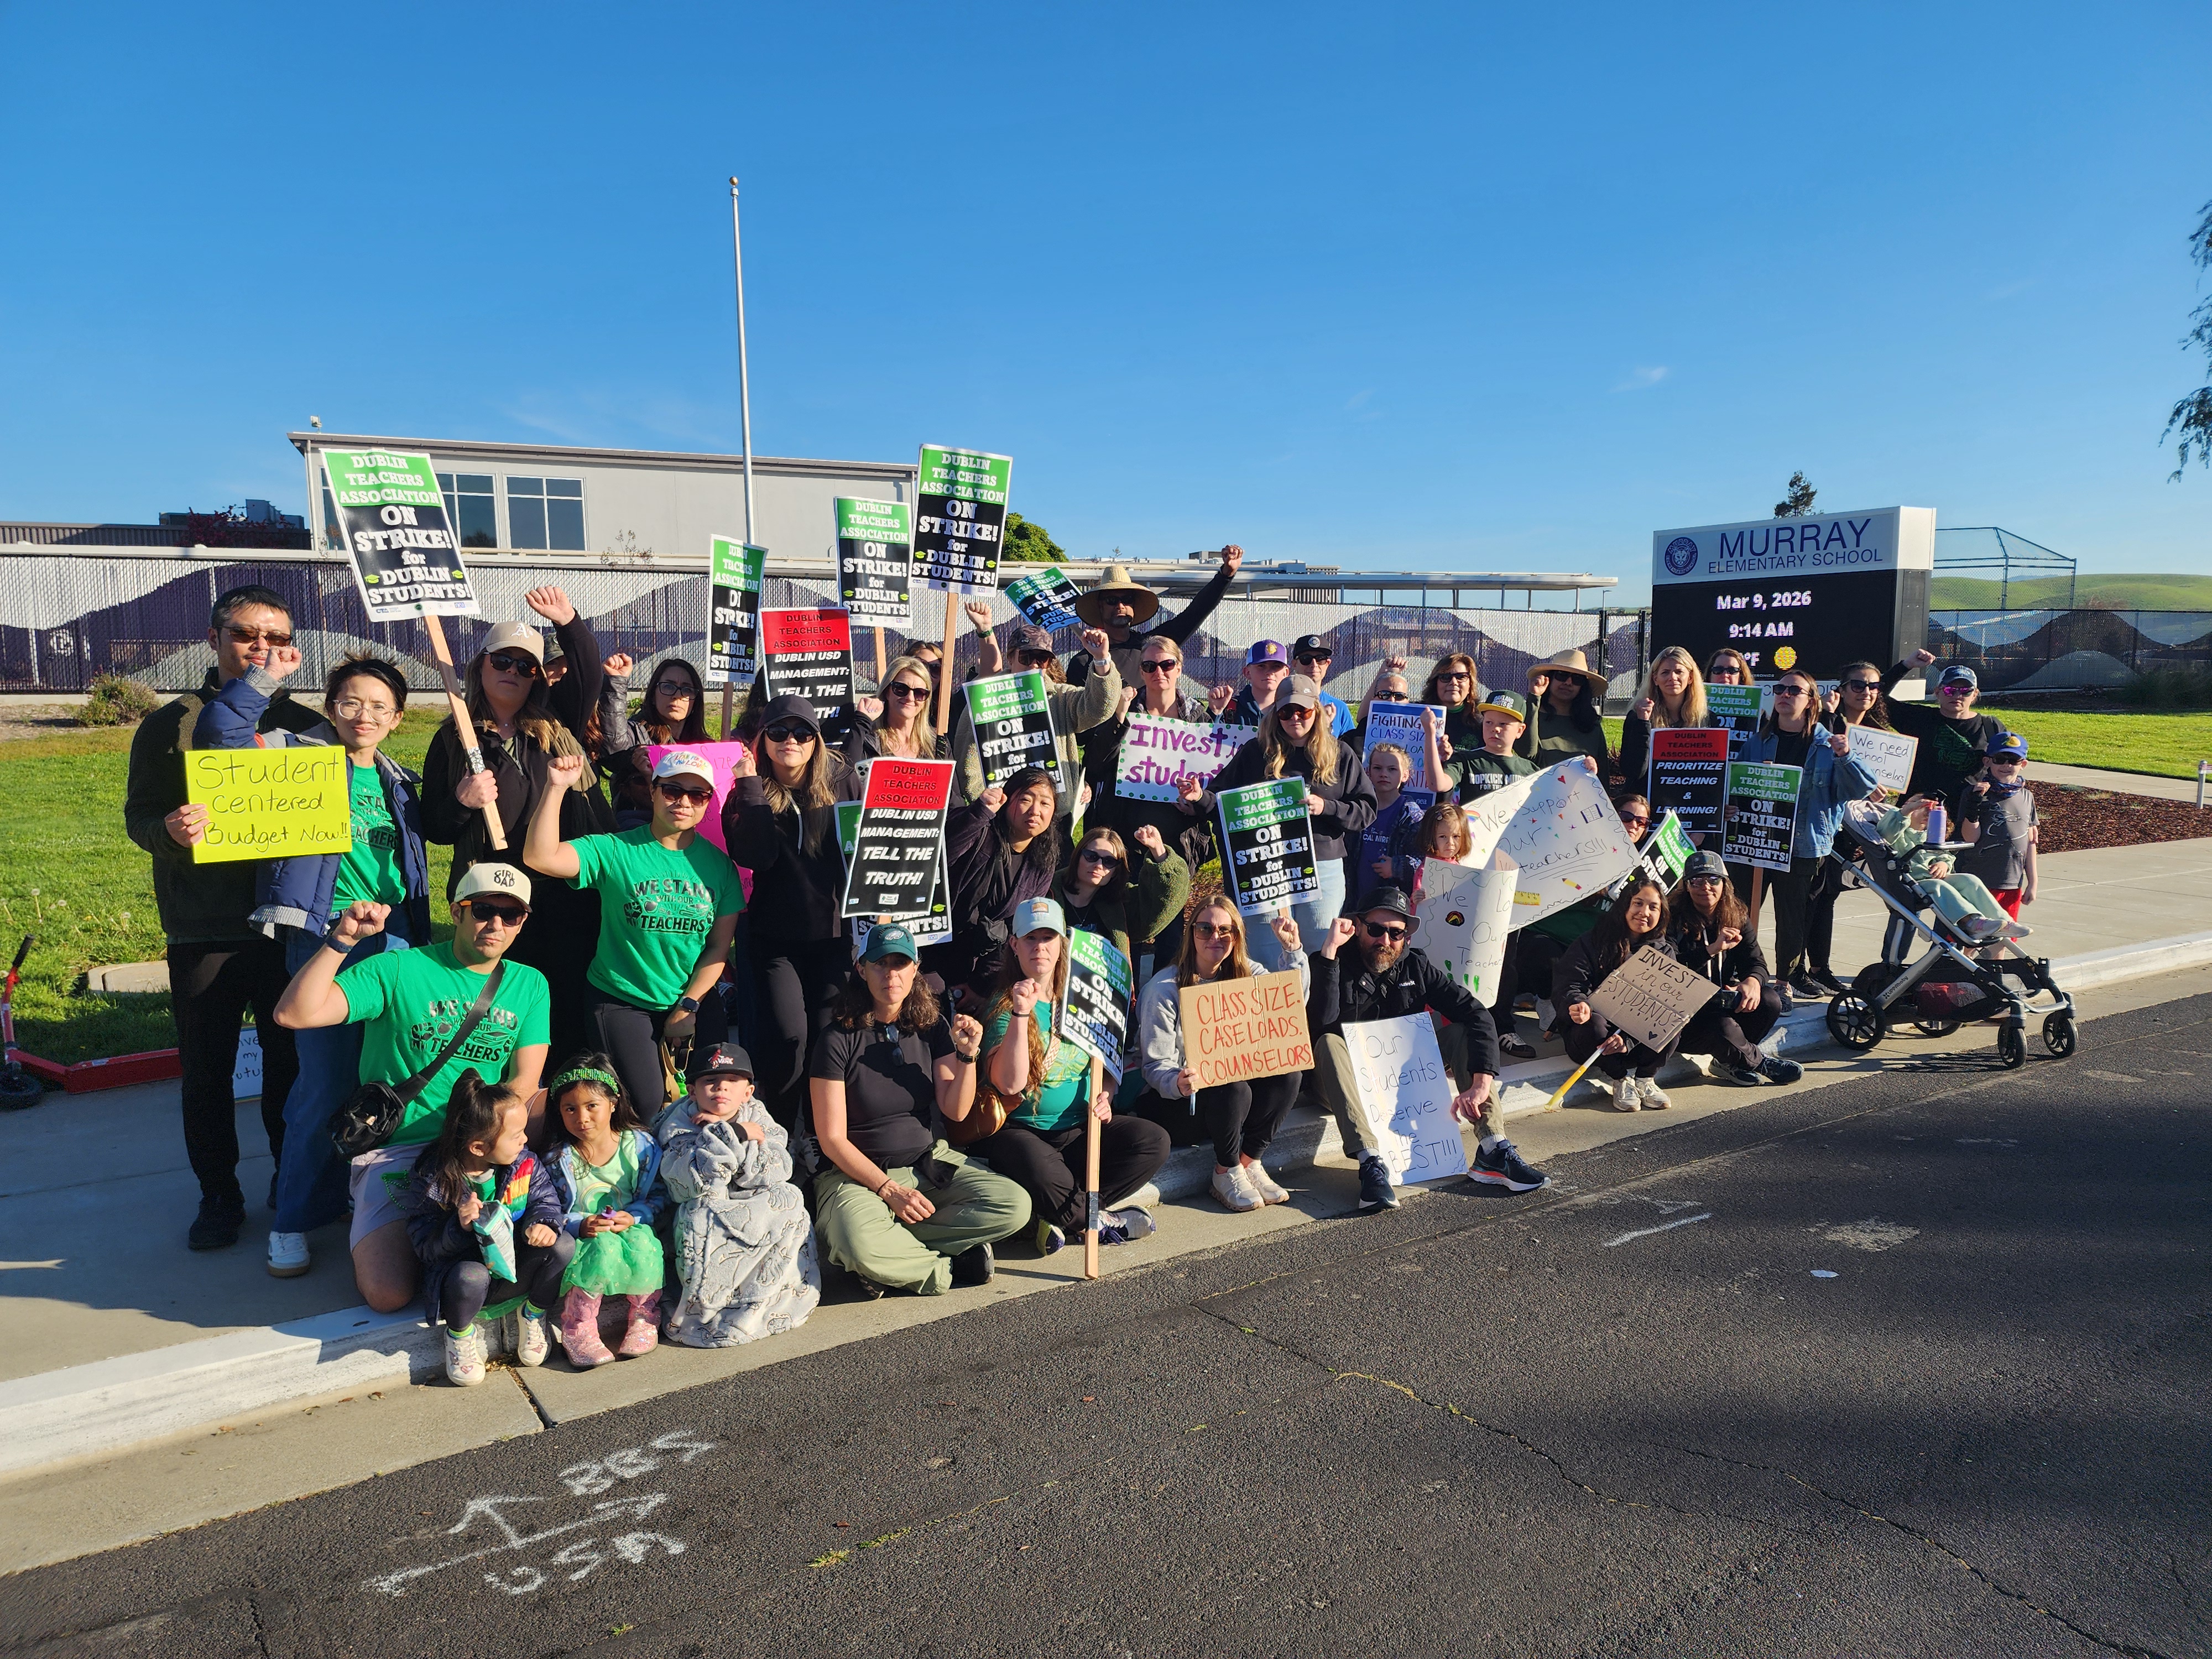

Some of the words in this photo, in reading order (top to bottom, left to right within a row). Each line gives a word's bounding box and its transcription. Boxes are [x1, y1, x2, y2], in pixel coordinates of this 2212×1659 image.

[351, 455, 409, 469] DUBLIN
[942, 453, 991, 470] DUBLIN
[345, 472, 424, 487] TEACHERS
[932, 467, 997, 486] TEACHERS
[340, 489, 440, 504] ASSOCIATION
[921, 482, 1004, 503] ASSOCIATION
[380, 505, 418, 526] ON
[855, 501, 892, 515] DUBLIN
[946, 500, 977, 519] ON
[848, 514, 900, 529] TEACHERS
[919, 516, 998, 542] STRIKE!
[354, 528, 452, 552] STRIKE!
[840, 527, 908, 542] ASSOCIATION
[1720, 518, 1872, 559] MURRAY
[864, 542, 887, 559] ON
[947, 539, 968, 552] for
[401, 551, 426, 566] for
[843, 558, 907, 577] STRIKE!
[926, 550, 985, 569] DUBLIN
[1709, 554, 1807, 573] ELEMENTARY
[1812, 548, 1883, 566] SCHOOL
[380, 566, 452, 586] DUBLIN
[869, 576, 884, 588] for
[912, 562, 995, 585] STUDENTS!
[1016, 573, 1047, 587] DUBLIN
[368, 584, 471, 604] STUDENTS!
[1015, 577, 1067, 604] ASSOCIATION
[1016, 576, 1056, 594] TEACHERS
[855, 588, 900, 602] DUBLIN
[1026, 589, 1077, 616] STRIKE!
[1035, 589, 1056, 601] ON
[1717, 594, 1749, 610] Mar
[1752, 593, 1767, 610] 9,
[1771, 591, 1812, 607] 2026
[843, 601, 910, 615] STUDENTS!
[786, 614, 823, 622] DUBLIN
[779, 626, 832, 635] TEACHERS
[1728, 623, 1762, 638] 9:14
[1764, 621, 1794, 637] AM
[774, 638, 841, 648] ASSOCIATION
[775, 653, 816, 662] DUBLIN
[818, 651, 842, 660] USD
[770, 667, 850, 680] MANAGEMENT:
[816, 684, 847, 697] THE
[985, 679, 1022, 693] DUBLIN
[1711, 687, 1746, 696] DUBLIN
[980, 690, 1034, 707] TEACHERS
[1493, 695, 1514, 704] OAKLAND
[975, 701, 1045, 722] ASSOCIATION
[998, 718, 1024, 735] ON
[1371, 714, 1421, 729] FIGHTING
[982, 730, 1050, 758] STRIKE!
[1129, 724, 1228, 758] Invest
[1371, 728, 1405, 740] CLASS
[1408, 731, 1439, 743] SIZS
[1854, 732, 1874, 750] We
[1880, 742, 1910, 757] need
[1008, 754, 1026, 765] for
[196, 753, 339, 789] Student
[893, 766, 932, 776] DUBLIN
[1747, 767, 1785, 778] DUBLIN
[884, 780, 937, 790] TEACHERS
[1660, 776, 1718, 785] TEACHING
[1740, 776, 1790, 790] TEACHERS
[212, 789, 325, 813] centered
[874, 794, 940, 805] ASSOCIATION
[1240, 785, 1284, 802] DUBLIN
[1730, 786, 1796, 801] ASSOCIATION
[870, 808, 914, 820] DUBLIN
[916, 810, 938, 820] USD
[1234, 796, 1293, 817] TEACHERS
[1479, 804, 1510, 832] We
[1518, 790, 1580, 816] Support
[1656, 806, 1718, 814] LEARNING!
[1751, 800, 1775, 813] ON
[1228, 806, 1306, 831] ASSOCIATION
[1730, 812, 1791, 830] STRIKE!
[203, 822, 289, 852] Budget
[300, 822, 349, 842] Now!!
[860, 827, 940, 838] MANAGEMENT:
[1255, 824, 1282, 843] ON
[1496, 827, 1542, 855] Our
[1752, 827, 1767, 837] for
[1235, 836, 1308, 866] STRIKE!
[1737, 834, 1781, 850] DUBLIN
[863, 847, 901, 860] TELL
[905, 847, 935, 860] THE
[1725, 843, 1789, 862] STUDENTS!
[1265, 860, 1283, 873] for
[1655, 855, 1669, 875] ON
[494, 870, 515, 880] GIRL
[494, 876, 515, 887] DAD
[865, 872, 924, 885] TRUTH!
[1250, 867, 1302, 889] DUBLIN
[1856, 872, 1870, 885] VISTA
[634, 879, 660, 898] WE
[1240, 877, 1317, 904] STUDENTS!
[1442, 874, 1468, 907] We
[677, 895, 693, 904] OUR
[640, 916, 706, 932] TEACHERS
[1472, 921, 1507, 945] Our
[1089, 935, 1123, 967] DUBLIN
[1082, 942, 1126, 982] TEACHERS
[1639, 949, 1700, 988] INVEST
[1072, 949, 1129, 999] ASSOCIATION
[1092, 974, 1114, 1001] ON
[1636, 968, 1656, 987] in
[1660, 982, 1684, 1001] our
[429, 999, 459, 1018] WE
[1072, 976, 1126, 1032] STRIKE!
[1197, 992, 1246, 1025] CLASS
[1250, 983, 1301, 1015] SIZE.
[1609, 979, 1677, 1026] STUDENTS
[1093, 1006, 1108, 1025] for
[1077, 1008, 1118, 1050] DUBLIN
[1066, 1013, 1121, 1071] STUDENTS!
[1365, 1035, 1402, 1058] Our
[243, 1052, 258, 1062] my
[1200, 1044, 1313, 1085] COUNSELORS.
[1360, 1057, 1437, 1093] Students
[1370, 1100, 1438, 1123] Deserve
[1388, 1139, 1457, 1173] BEST!!!
